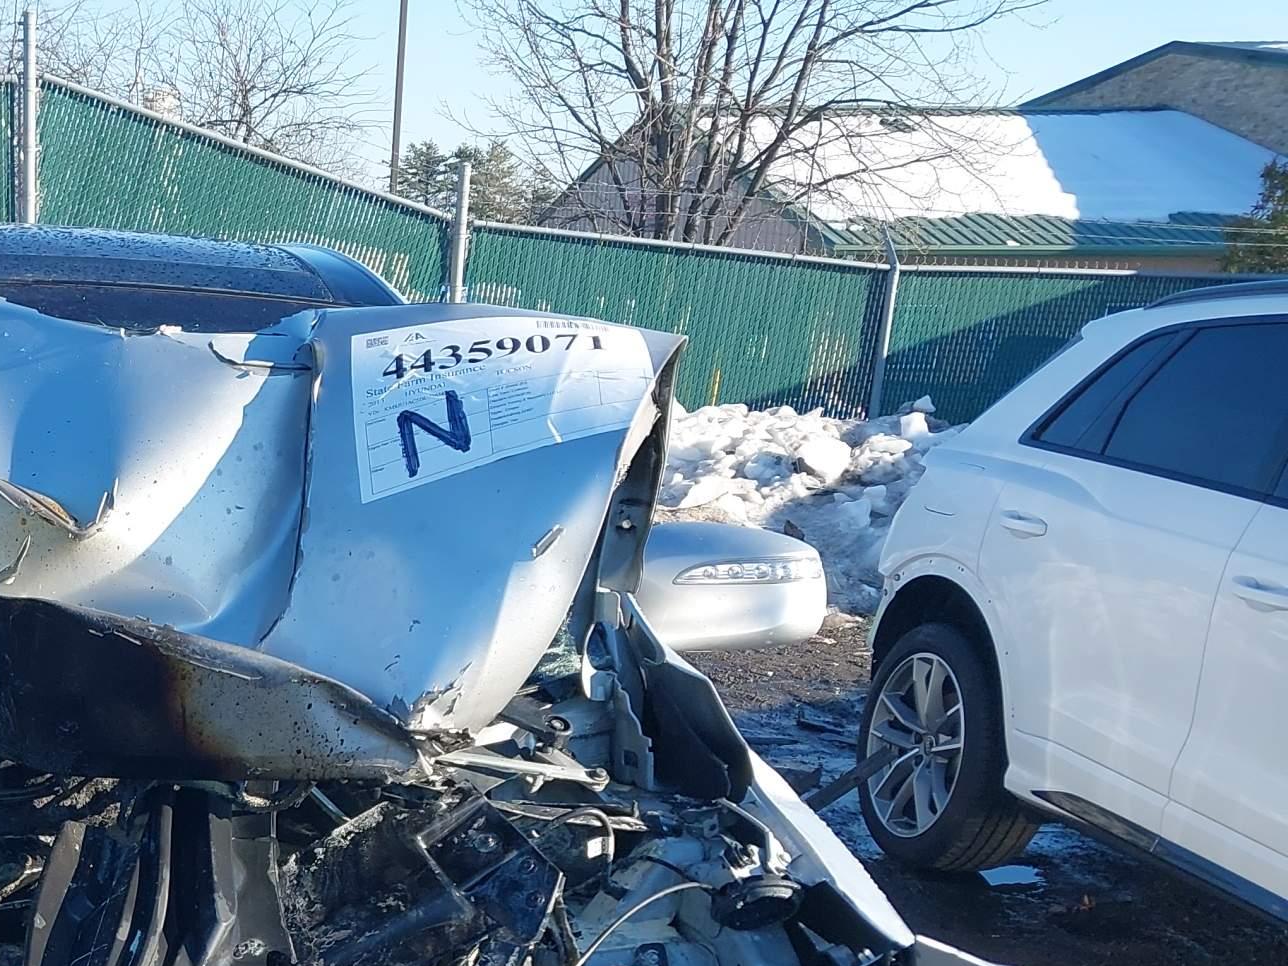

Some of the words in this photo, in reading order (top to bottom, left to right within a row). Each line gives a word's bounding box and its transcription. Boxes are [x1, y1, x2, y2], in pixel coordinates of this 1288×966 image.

[382, 332, 605, 380] 44359071
[397, 376, 427, 389] Farm
[430, 364, 487, 380] Insurance
[396, 389, 472, 479] N
